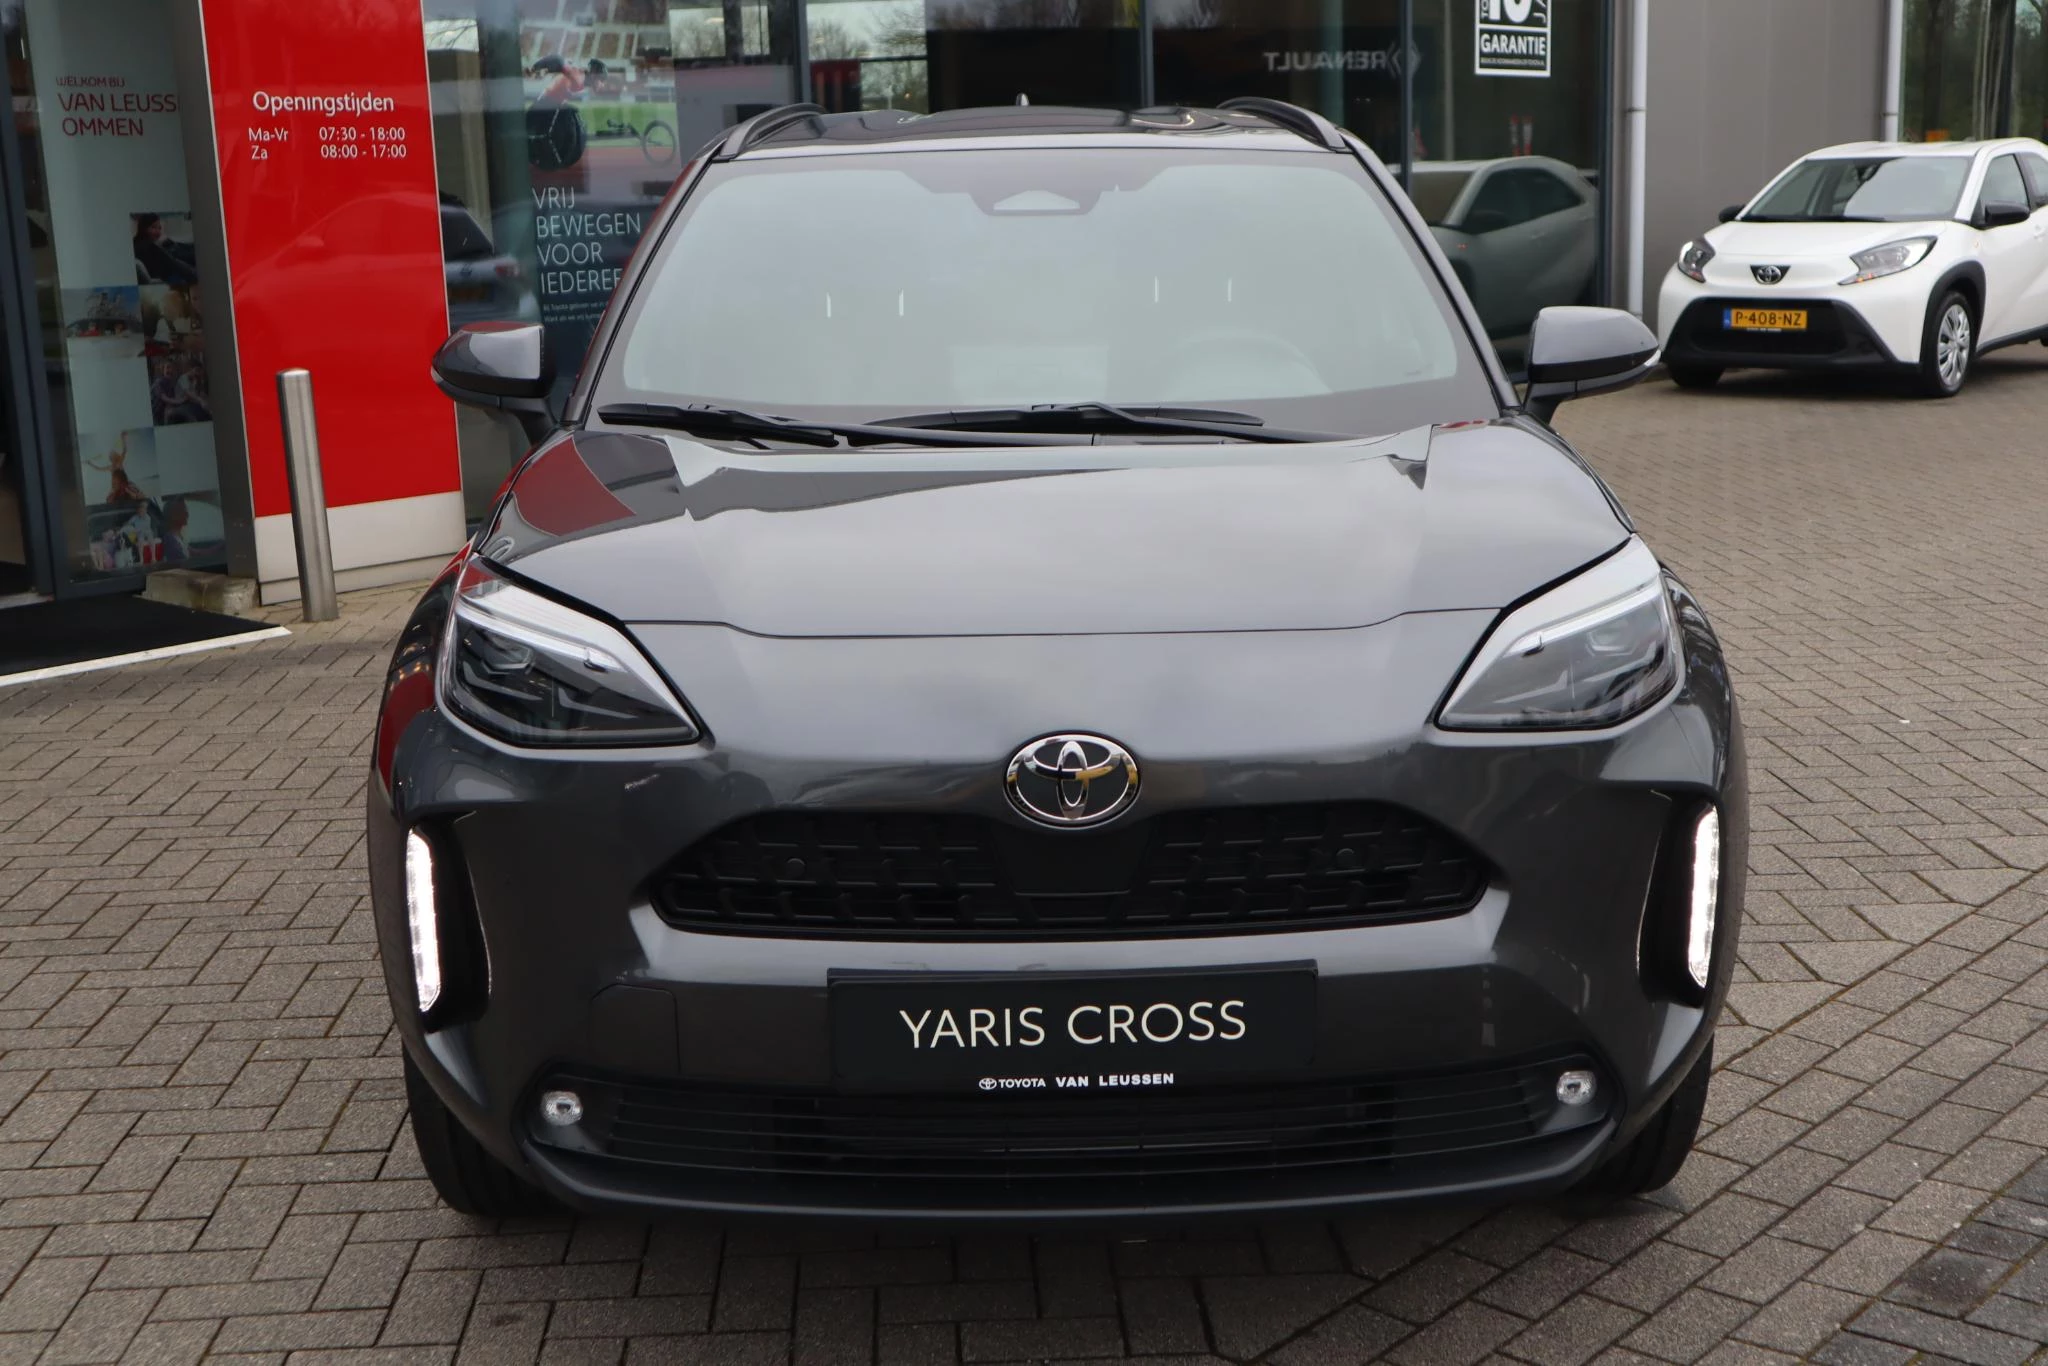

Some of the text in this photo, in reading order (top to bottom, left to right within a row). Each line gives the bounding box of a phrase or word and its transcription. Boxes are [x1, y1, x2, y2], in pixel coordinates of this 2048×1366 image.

[1480, 33, 1546, 56] GARANTIE
[56, 76, 125, 88] WELKOM BIJ
[58, 93, 181, 112] VAN LEUSS
[252, 91, 395, 117] Openingstijden
[62, 117, 144, 136] OMMEN
[248, 127, 289, 142] Ma-Vr
[319, 127, 357, 141] 07:30
[369, 127, 406, 141] 18:00
[251, 145, 268, 160] Za
[320, 144, 358, 158] 08:00
[370, 144, 407, 158] 17:00
[532, 186, 575, 209] VRIJ
[536, 212, 641, 238] BEWEGEN
[537, 241, 603, 267] VOOR
[1735, 311, 1802, 326] P-408-NZ
[900, 1001, 1246, 1048] YARIS CROSS
[999, 1073, 1174, 1089] TOYOTA VAN LEUSSEN
